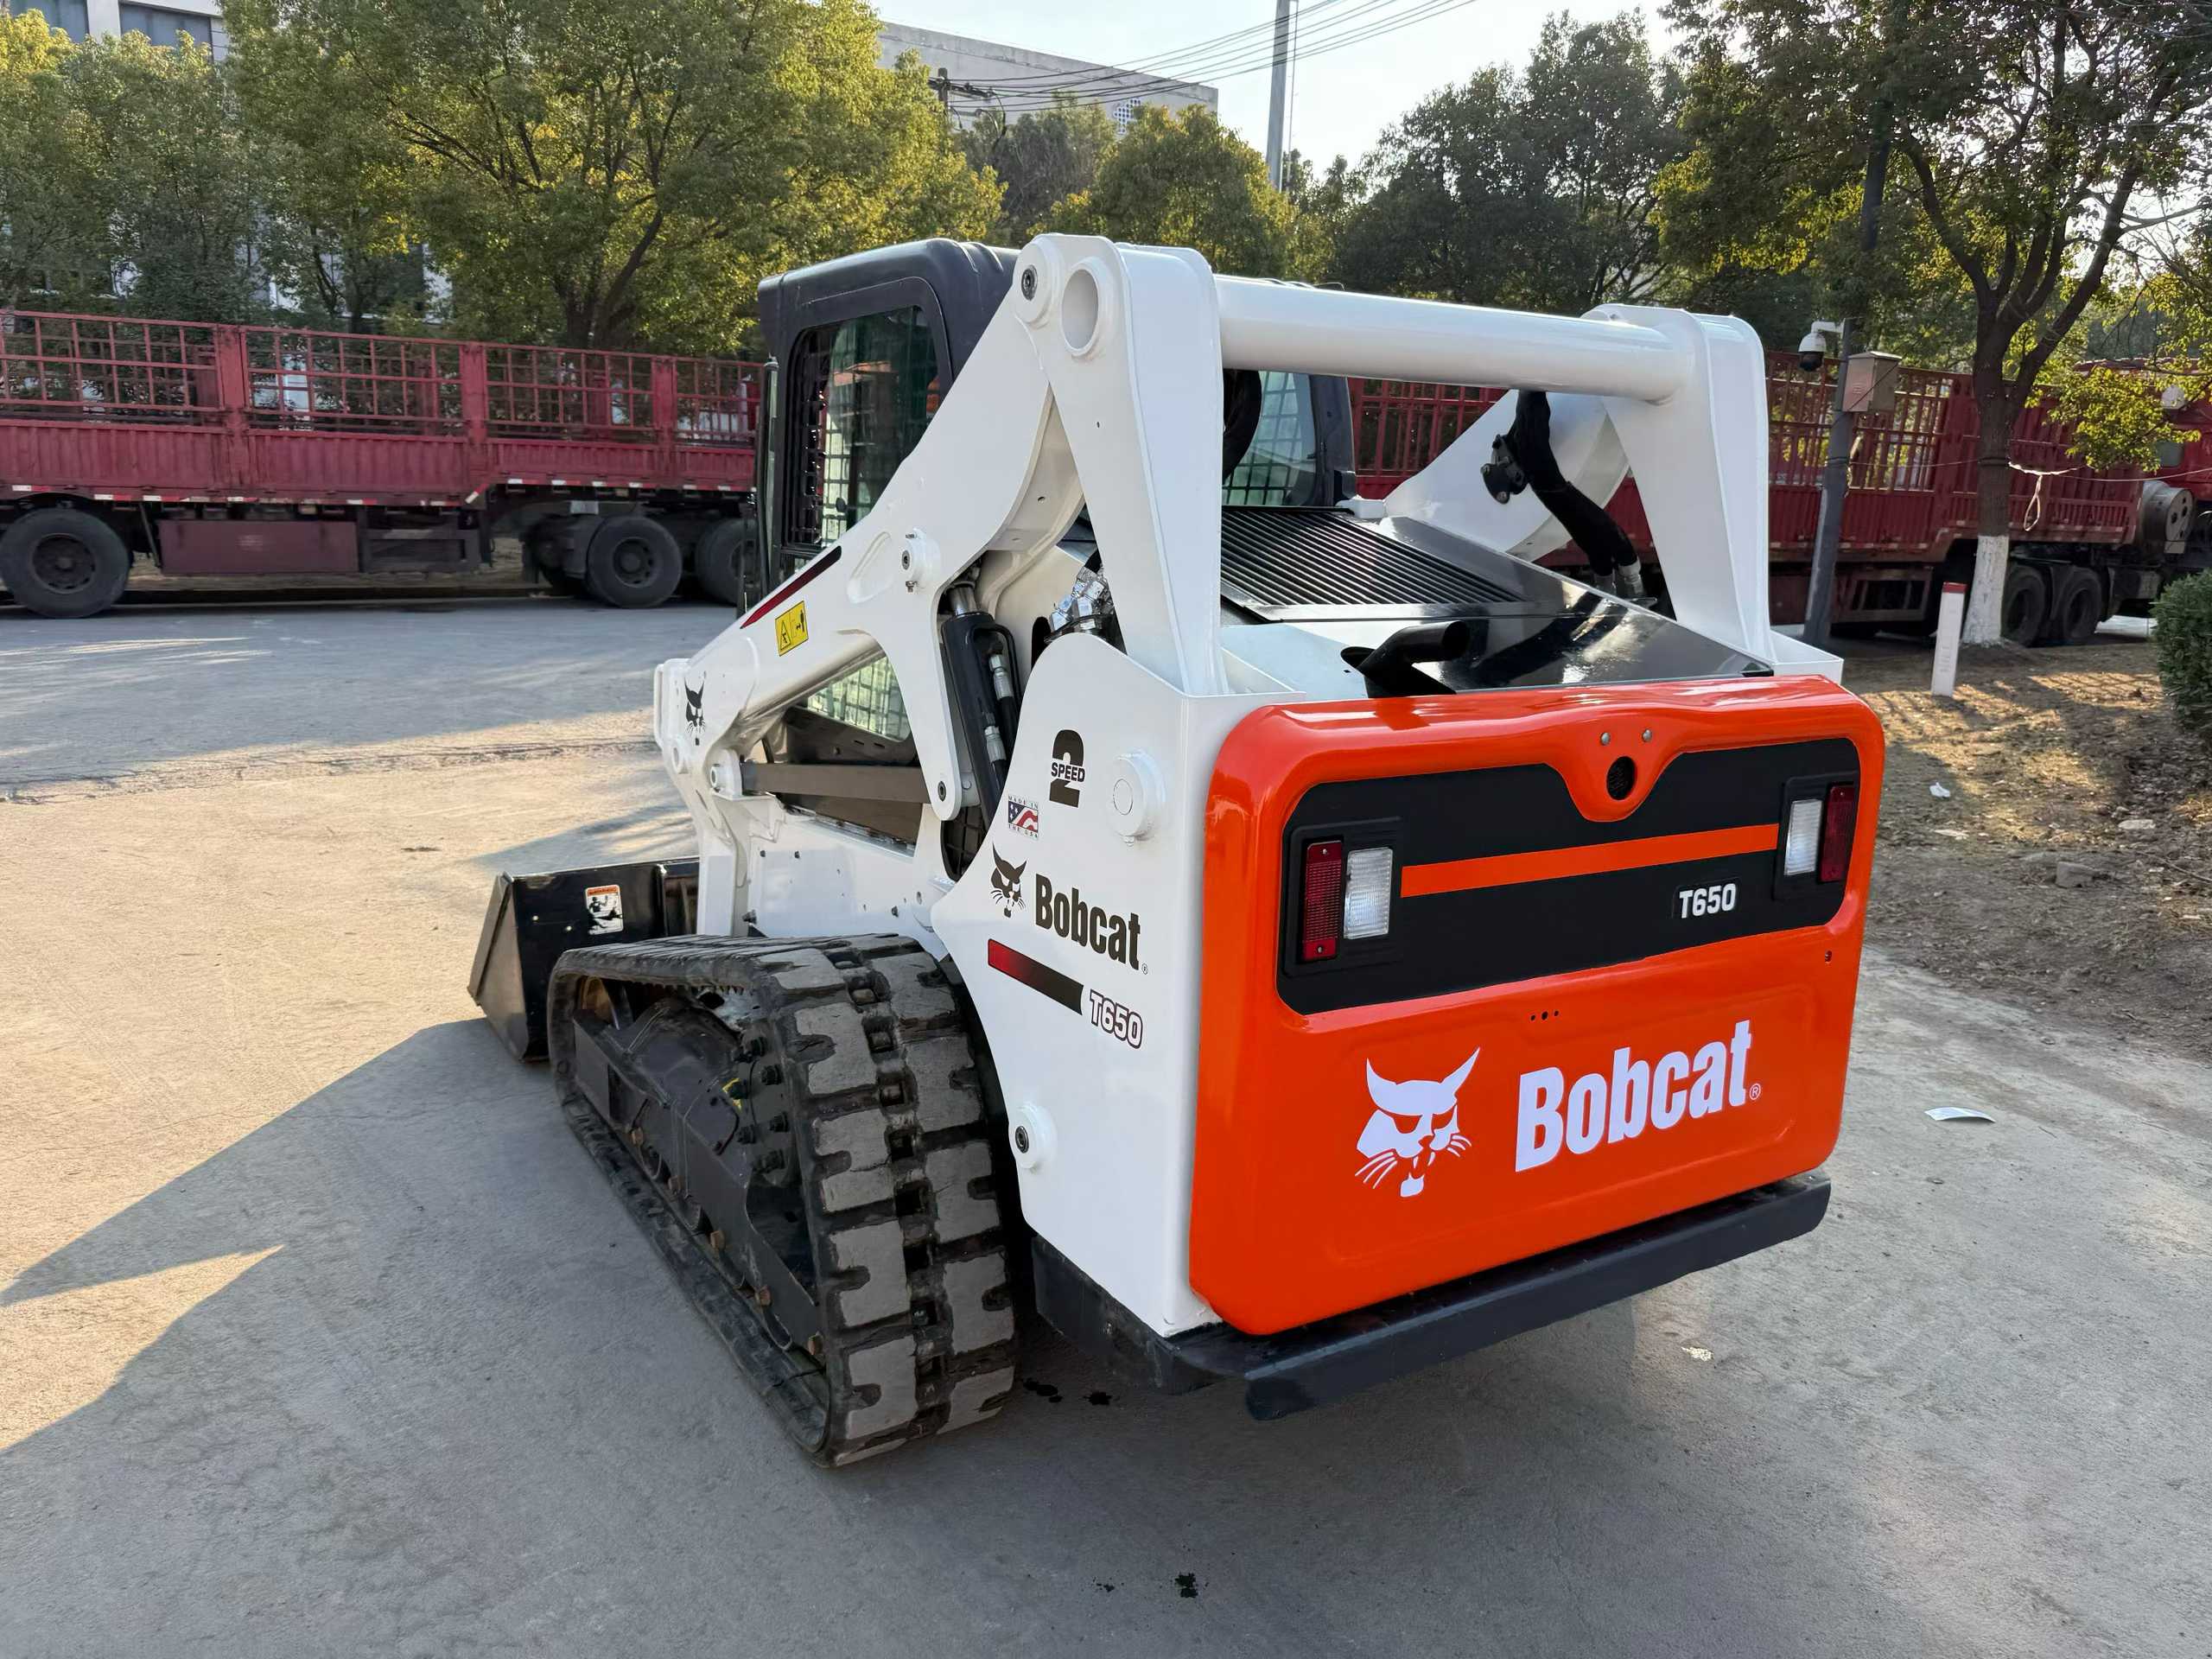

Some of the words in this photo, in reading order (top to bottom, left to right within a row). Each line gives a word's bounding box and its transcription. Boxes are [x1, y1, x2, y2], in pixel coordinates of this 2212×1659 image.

[1049, 729, 1084, 808] 2
[1051, 762, 1085, 782] SPEED
[1036, 874, 1141, 970] Bobcat
[1679, 883, 1737, 919] T650
[1090, 988, 1143, 1049] T650
[1516, 1019, 1751, 1173] Bobcat
